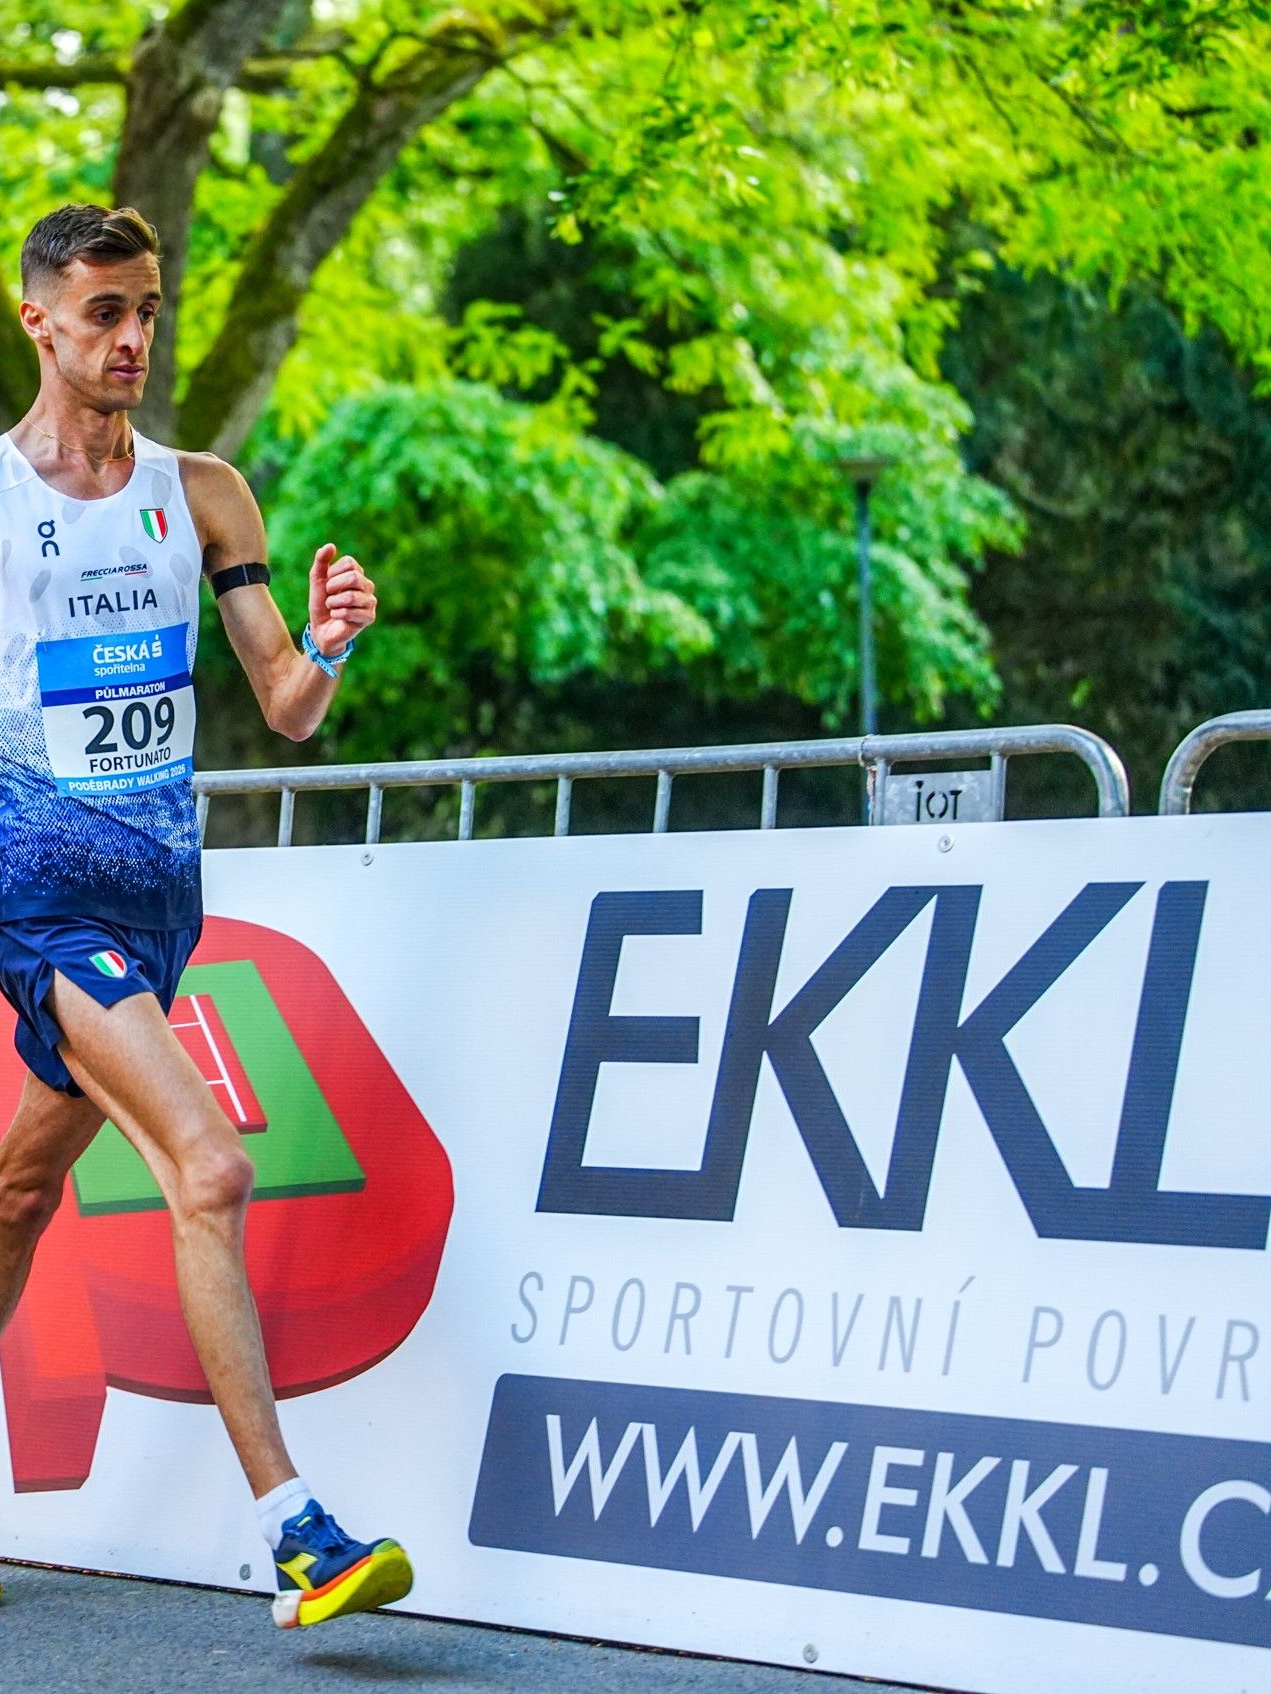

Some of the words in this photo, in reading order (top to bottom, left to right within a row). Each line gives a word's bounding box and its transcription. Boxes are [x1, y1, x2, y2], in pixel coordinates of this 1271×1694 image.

[81, 563, 148, 579] FRECCIAROSSA
[68, 588, 158, 618] ITALIA
[92, 640, 151, 664] ČESKÁ
[93, 662, 146, 677] spořitelna
[95, 681, 166, 700] PŮLMARATON
[82, 696, 176, 756] 209
[89, 747, 171, 774] FORTUNATO
[68, 776, 135, 793] PODĚBRADY
[136, 768, 171, 786] WALKING
[170, 763, 186, 778] 2026
[535, 880, 1271, 1251] EKKL
[510, 1270, 977, 1378] SPORTOVNÍ
[544, 1413, 1271, 1600] WWW.EKKL.C
